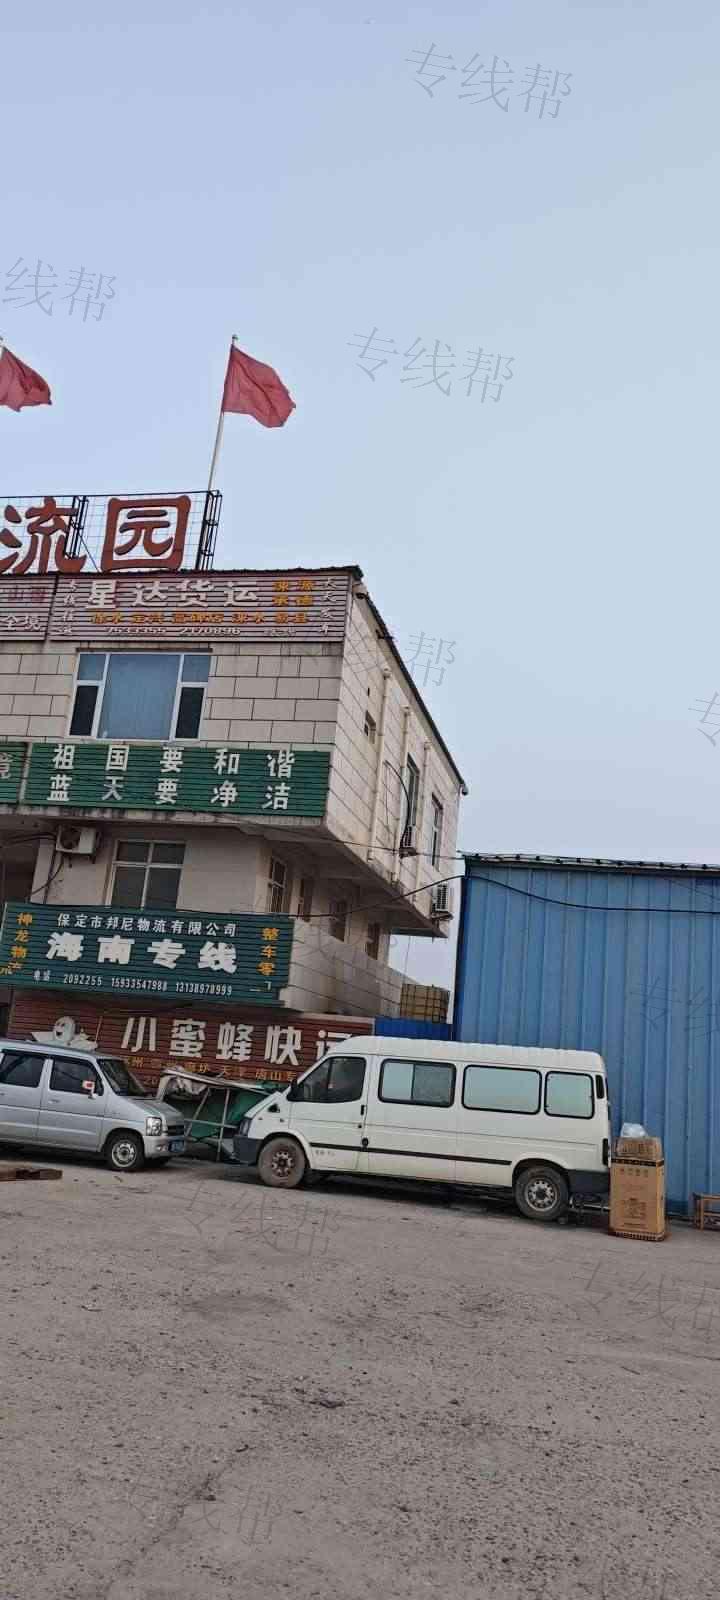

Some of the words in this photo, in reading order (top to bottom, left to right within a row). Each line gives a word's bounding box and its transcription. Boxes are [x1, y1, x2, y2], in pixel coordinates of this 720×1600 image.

[0, 495, 191, 574] 流园
[85, 579, 260, 609] 星达货运
[52, 743, 296, 779] 祖国要和谐
[46, 774, 292, 811] 蓝天要净洁
[57, 912, 237, 938] 保定市邦尼物流有限公司
[45, 931, 238, 975] 海南专线
[63, 973, 103, 986] 2092255
